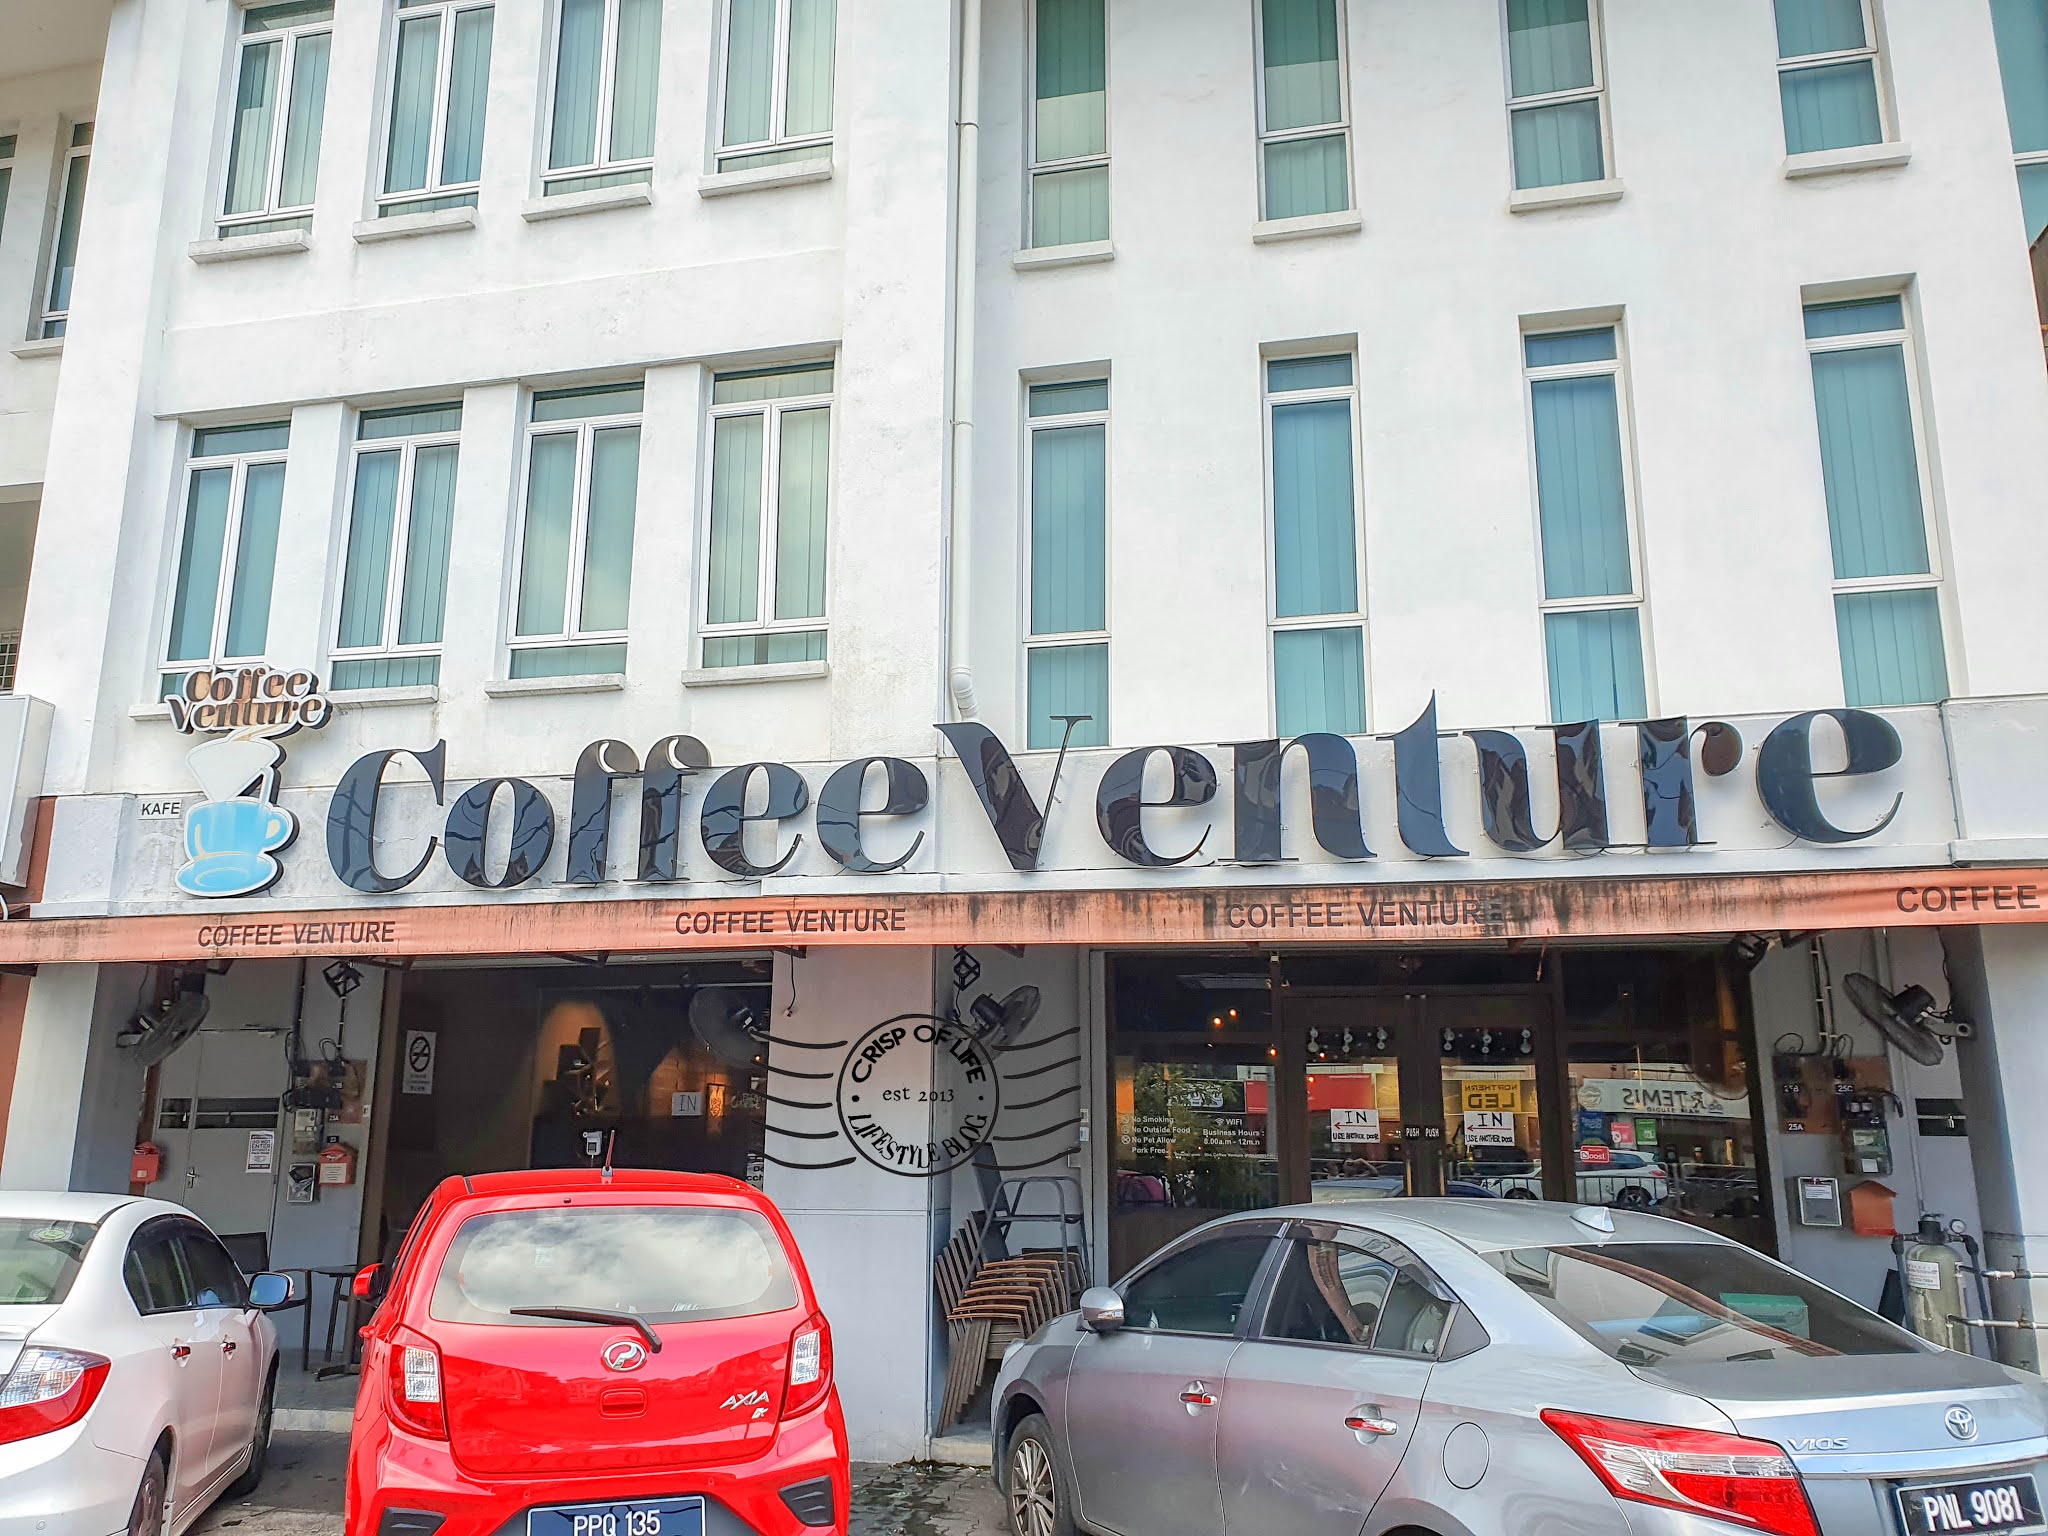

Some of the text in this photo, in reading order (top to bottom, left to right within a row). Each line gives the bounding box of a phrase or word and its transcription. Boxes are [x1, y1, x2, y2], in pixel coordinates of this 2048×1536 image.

[186, 667, 309, 702] Coffee
[167, 699, 322, 730] Venture
[141, 802, 181, 815] KAFE
[1896, 885, 2041, 913] COFFEE
[675, 908, 906, 934] COFFEE VENTURE
[1226, 900, 1502, 928] COFFEE VENTURE
[198, 921, 396, 947] COFFEE VENTURE
[678, 1094, 697, 1112] IN
[1142, 1116, 1174, 1125] Smoking
[1345, 1110, 1368, 1124] IN
[1477, 1112, 1502, 1126] IN
[1172, 1126, 1191, 1134] Food
[1405, 1127, 1420, 1137] PUSH
[1425, 1127, 1439, 1137] PUSH
[1788, 1123, 1803, 1131] 25A
[719, 1390, 769, 1410] AXIA
[1787, 1437, 1848, 1451] VIOS
[1922, 1485, 2024, 1532] PNL 9081
[574, 1509, 661, 1536] PPQ 135
